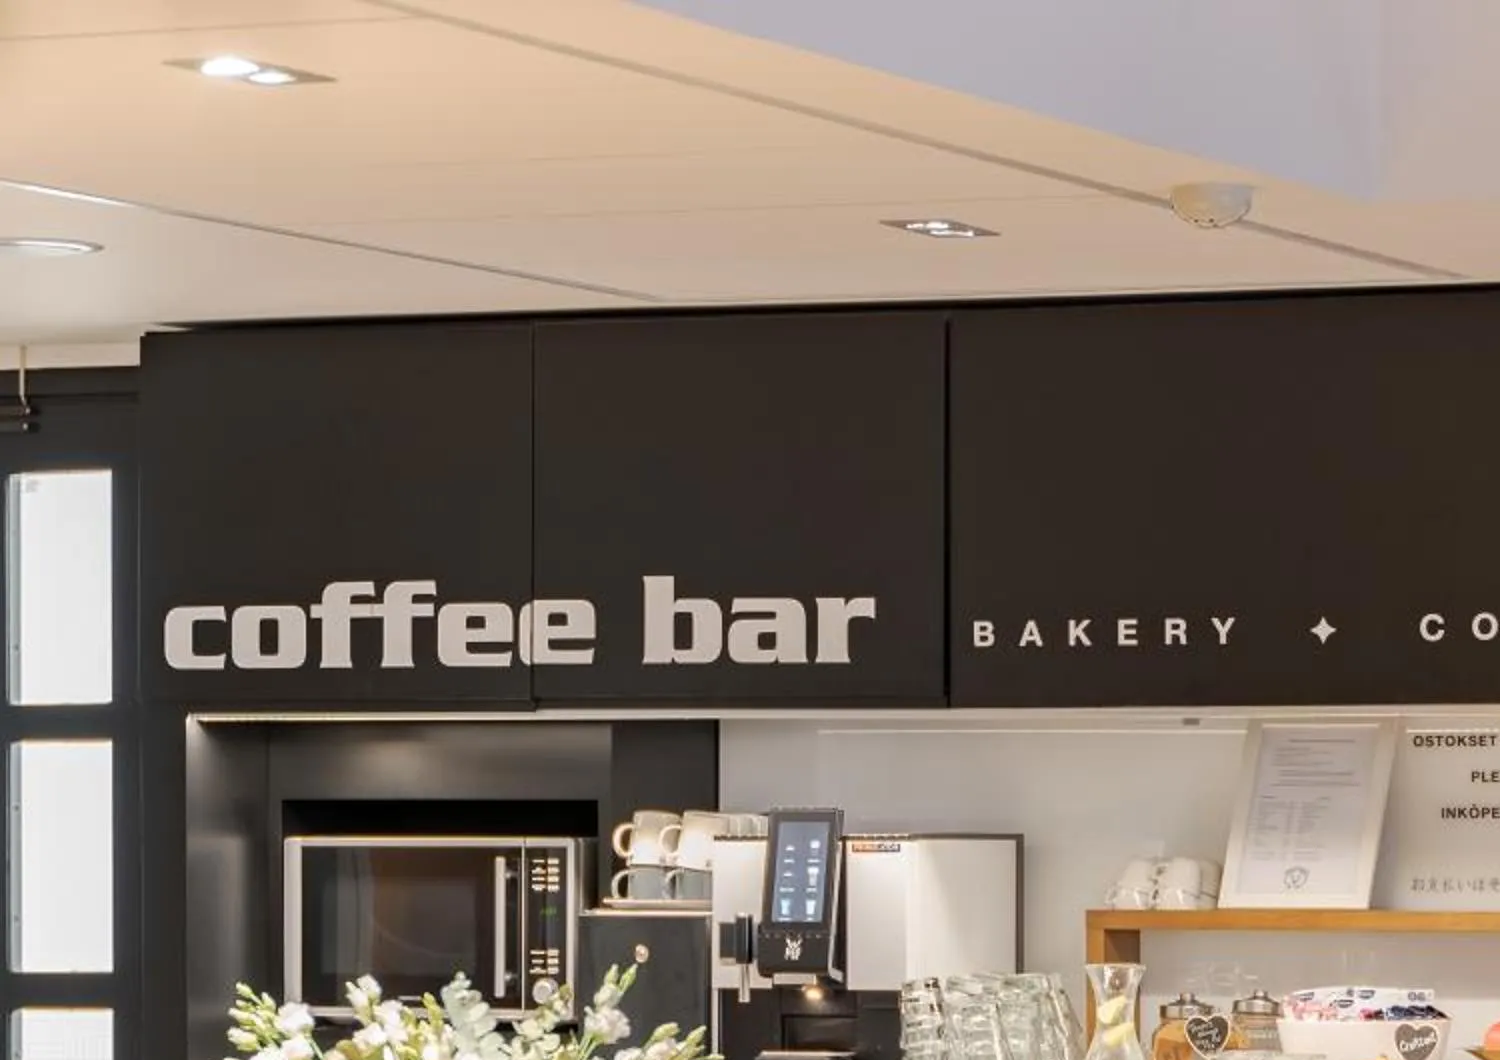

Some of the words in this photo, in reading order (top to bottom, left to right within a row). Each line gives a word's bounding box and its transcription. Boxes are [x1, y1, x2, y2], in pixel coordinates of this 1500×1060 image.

[164, 580, 597, 670] coffee
[642, 575, 876, 664] bar
[972, 616, 1236, 648] BAKERY
[1411, 734, 1498, 749] OSTOKSET
